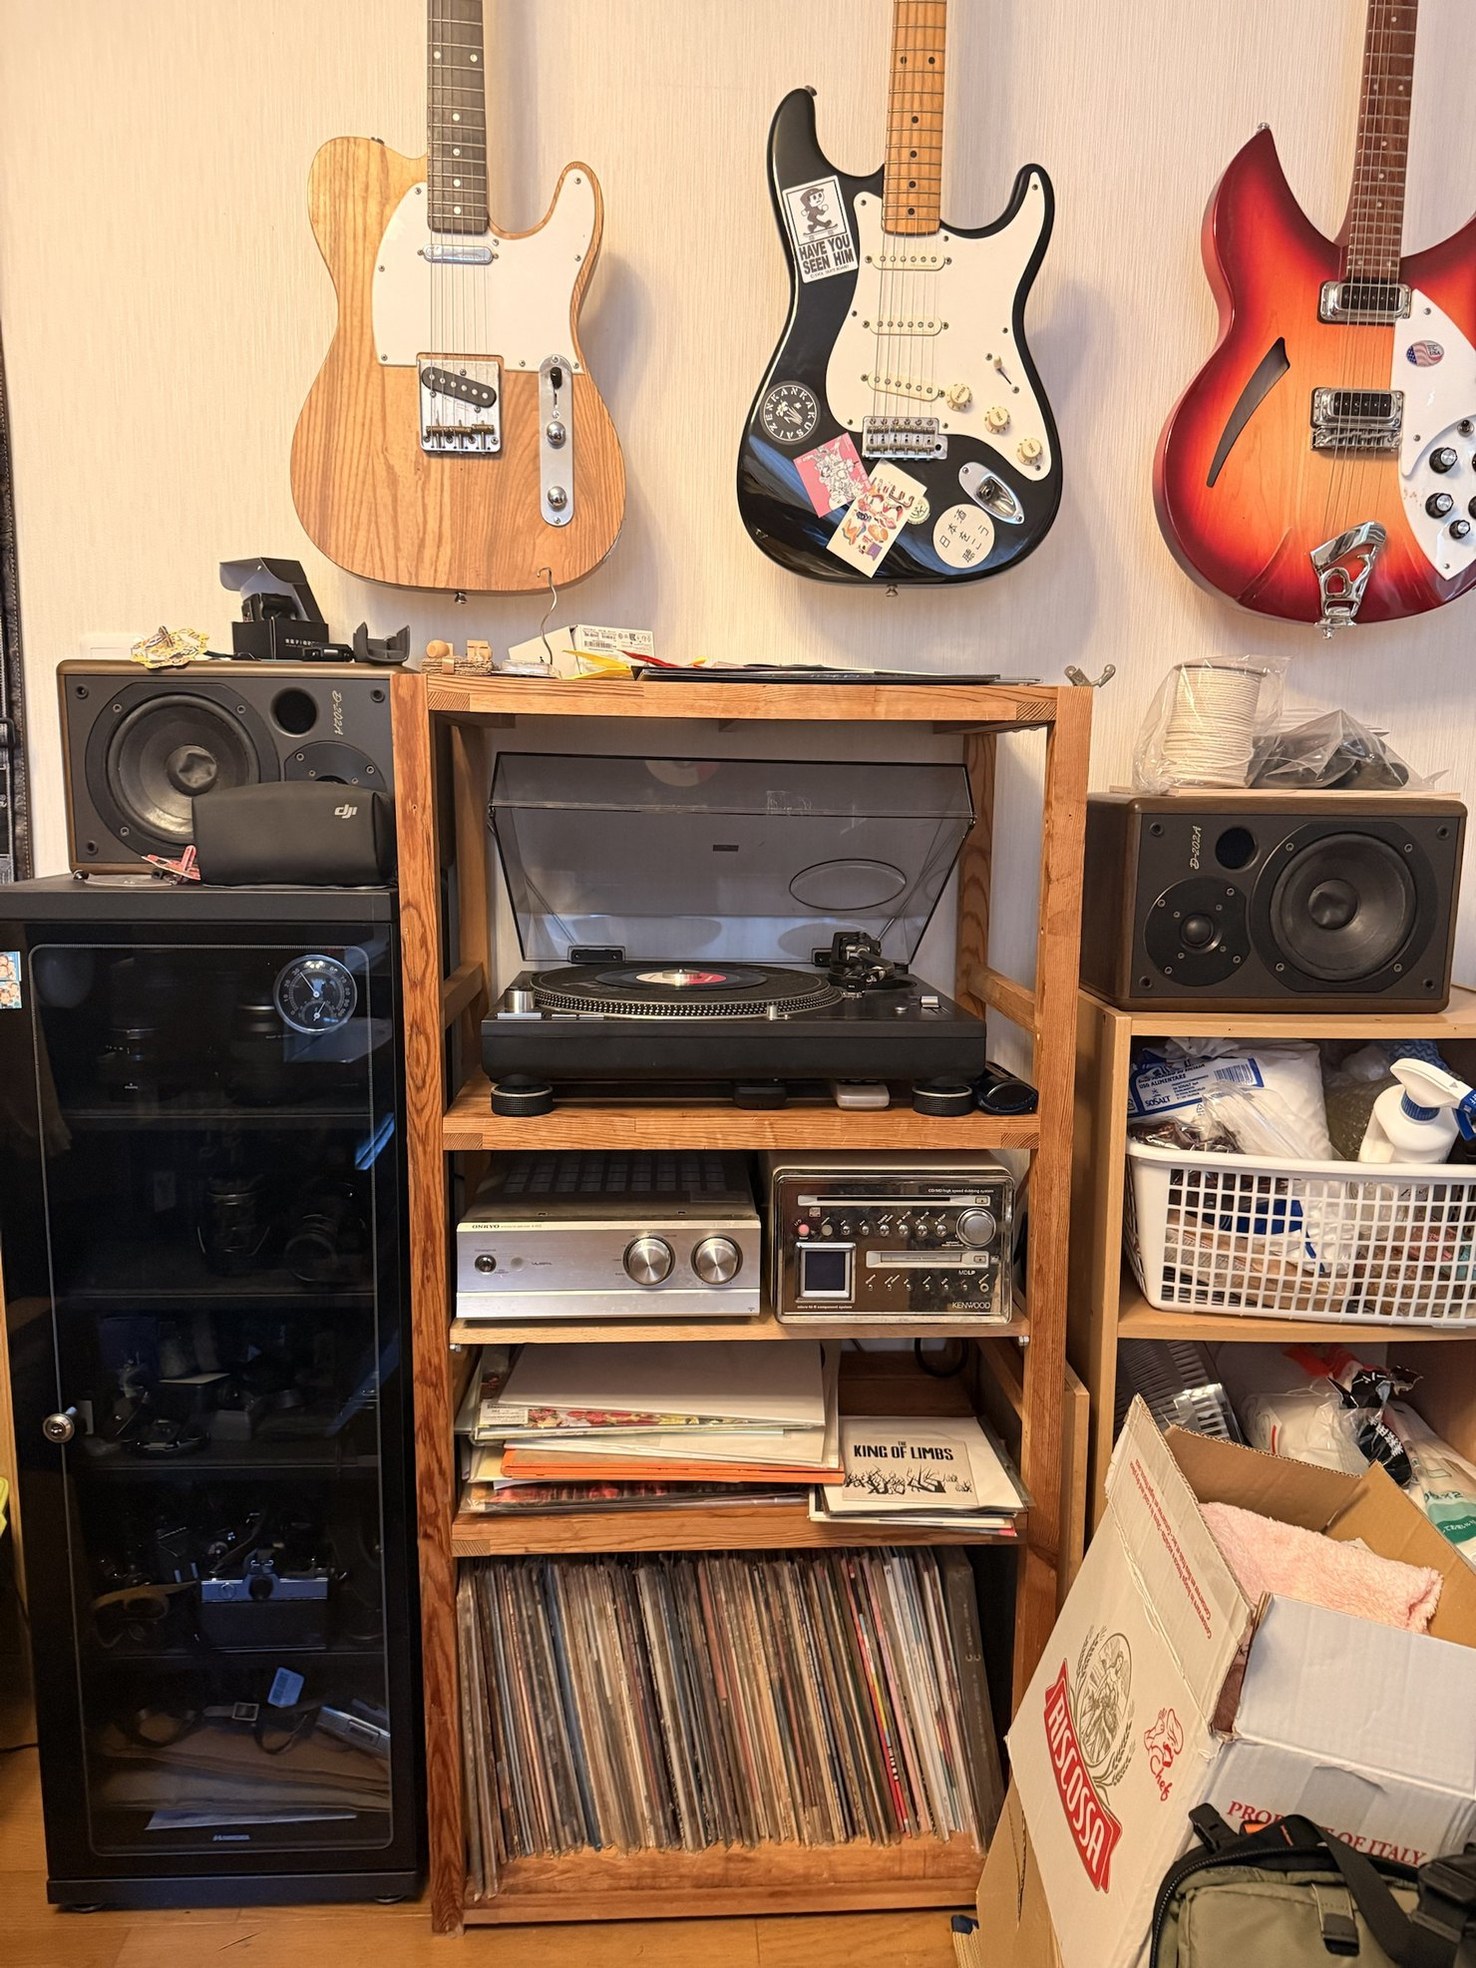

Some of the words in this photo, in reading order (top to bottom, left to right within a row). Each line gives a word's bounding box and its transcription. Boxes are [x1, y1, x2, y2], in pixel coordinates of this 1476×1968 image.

[799, 241, 827, 260] HAVE
[828, 234, 850, 252] YOU
[803, 255, 830, 275] SEEN
[833, 248, 854, 266] HIM
[940, 508, 967, 549] 日本酒
[959, 531, 971, 543] を
[331, 690, 344, 736] D-202A
[1190, 825, 1202, 870] D-202A
[1145, 1095, 1170, 1107] SOSALT
[951, 1301, 991, 1309] KENWOOD
[853, 1445, 888, 1458] KING
[891, 1446, 907, 1459] OF
[910, 1447, 954, 1461] LIMBS
[1048, 1692, 1105, 1874] RISCOSSA
[1150, 1754, 1173, 1802] Chef
[1367, 1839, 1427, 1869] ITALY
